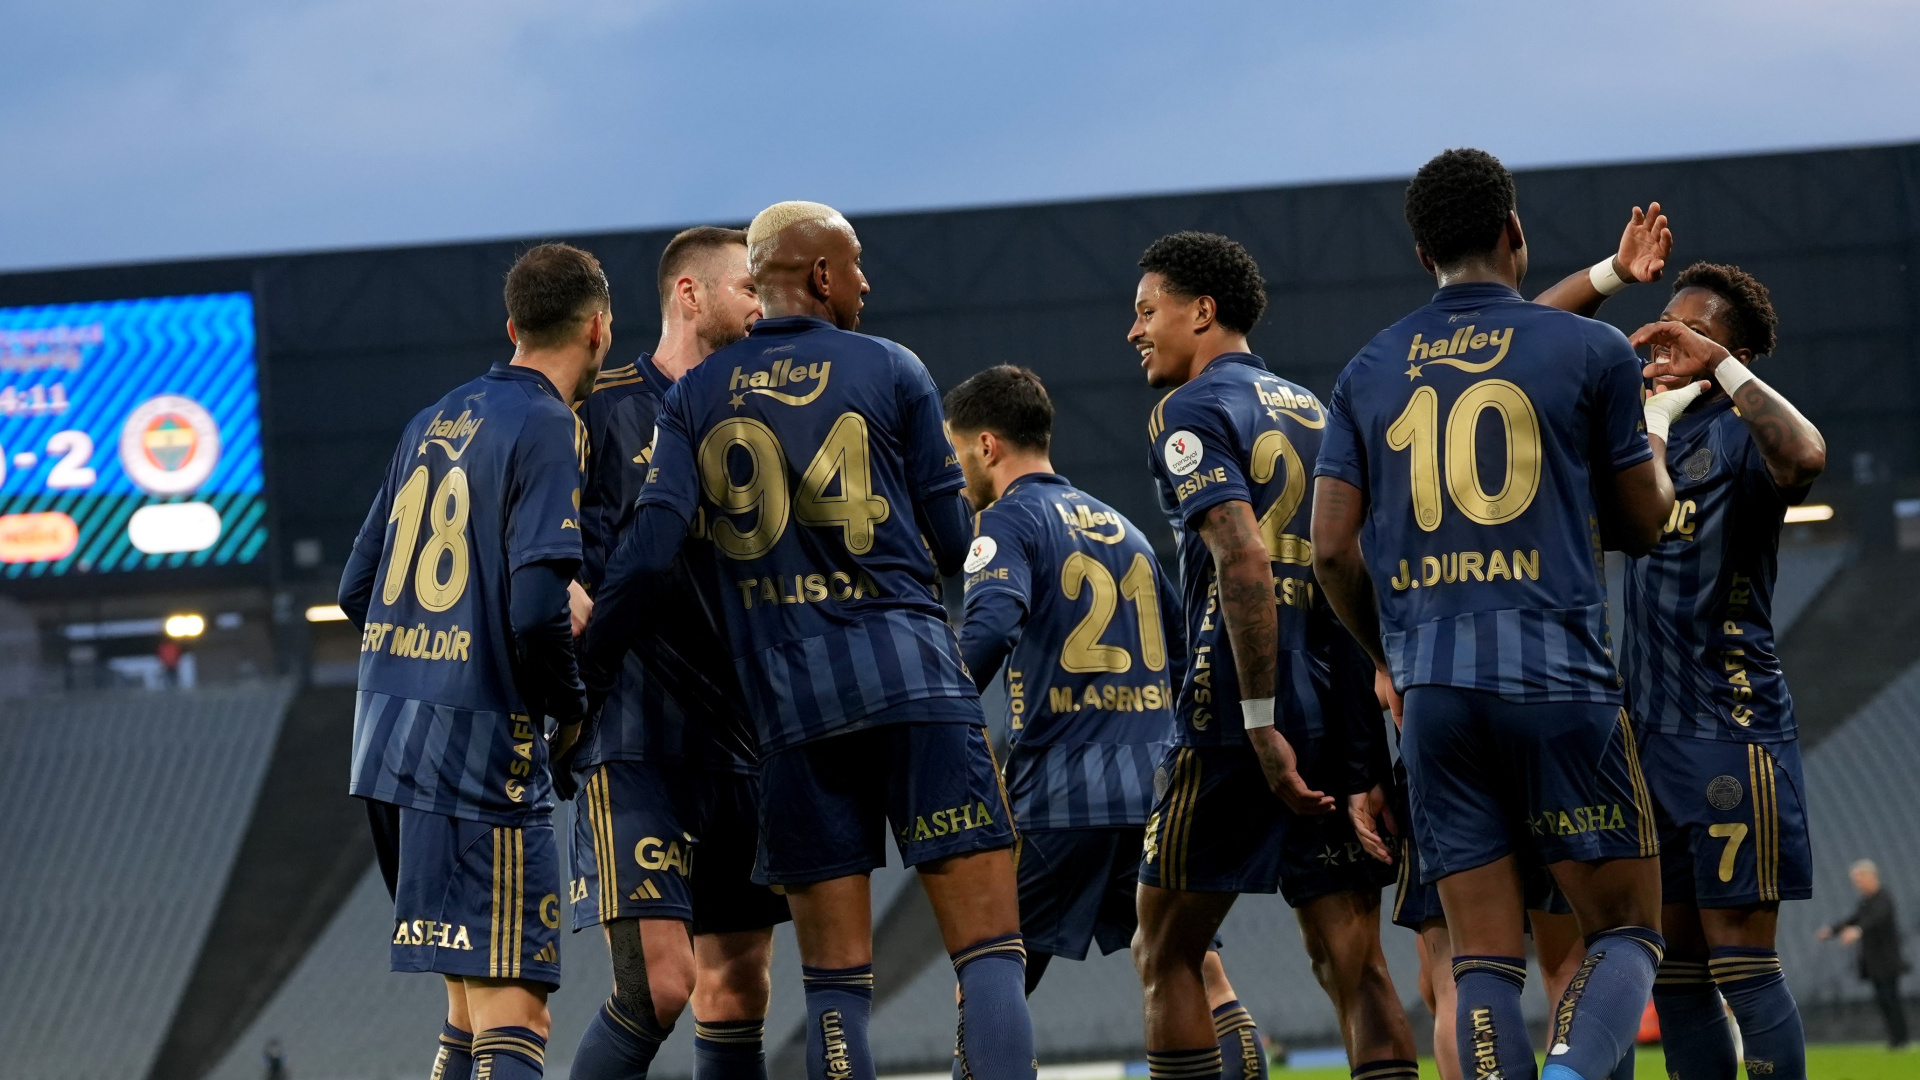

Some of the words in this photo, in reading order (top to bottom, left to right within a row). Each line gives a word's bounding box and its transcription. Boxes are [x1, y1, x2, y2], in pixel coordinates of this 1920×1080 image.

[1407, 325, 1514, 373] halley
[729, 358, 831, 406] halley
[1254, 381, 1326, 430] halley
[424, 409, 484, 461] halley
[1386, 378, 1542, 532] 10
[698, 412, 889, 560] 94
[382, 465, 470, 612] 18
[1055, 503, 1126, 545] halley
[737, 571, 880, 609] TALISCA
[1391, 549, 1540, 590] J.DURAN
[1060, 551, 1166, 673] 21
[390, 622, 472, 662] MÜLDÜR
[1008, 667, 1025, 730] PORT
[1708, 822, 1749, 883] 7
